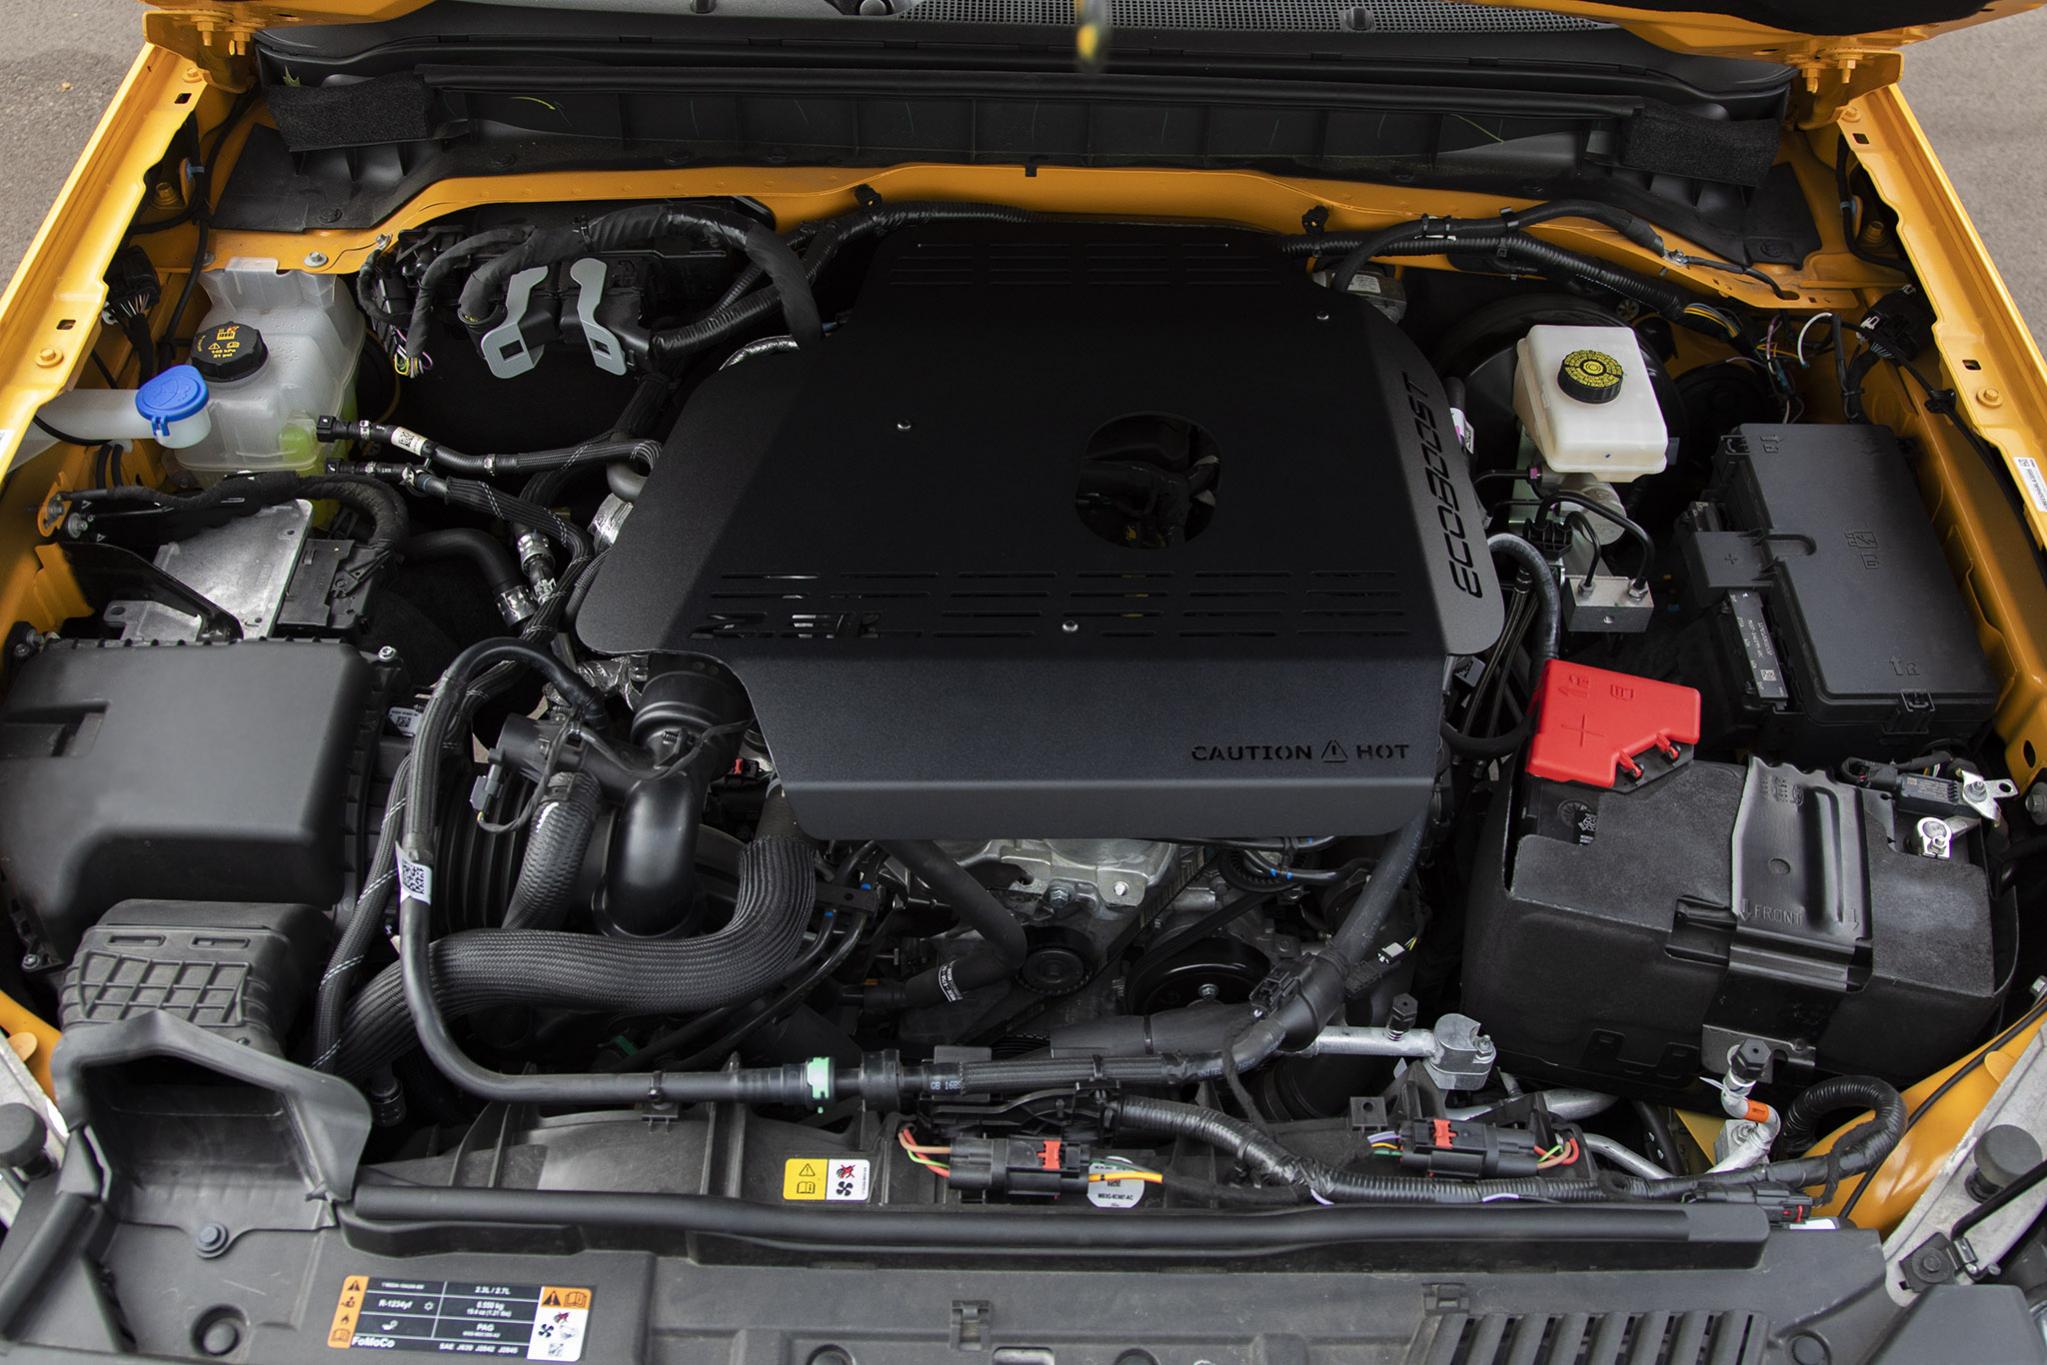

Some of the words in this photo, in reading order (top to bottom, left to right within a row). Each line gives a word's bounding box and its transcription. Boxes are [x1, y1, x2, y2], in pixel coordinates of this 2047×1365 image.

[1402, 371, 1483, 598] ECOBOOST
[1192, 745, 1312, 761] CAUTION
[1356, 744, 1409, 760] HOT
[1754, 904, 1803, 926] FRONT
[378, 1299, 413, 1310] R-1234yf
[476, 1323, 495, 1332] PAG
[351, 1336, 396, 1348] FoMoCo
[439, 1343, 454, 1351] SAE
